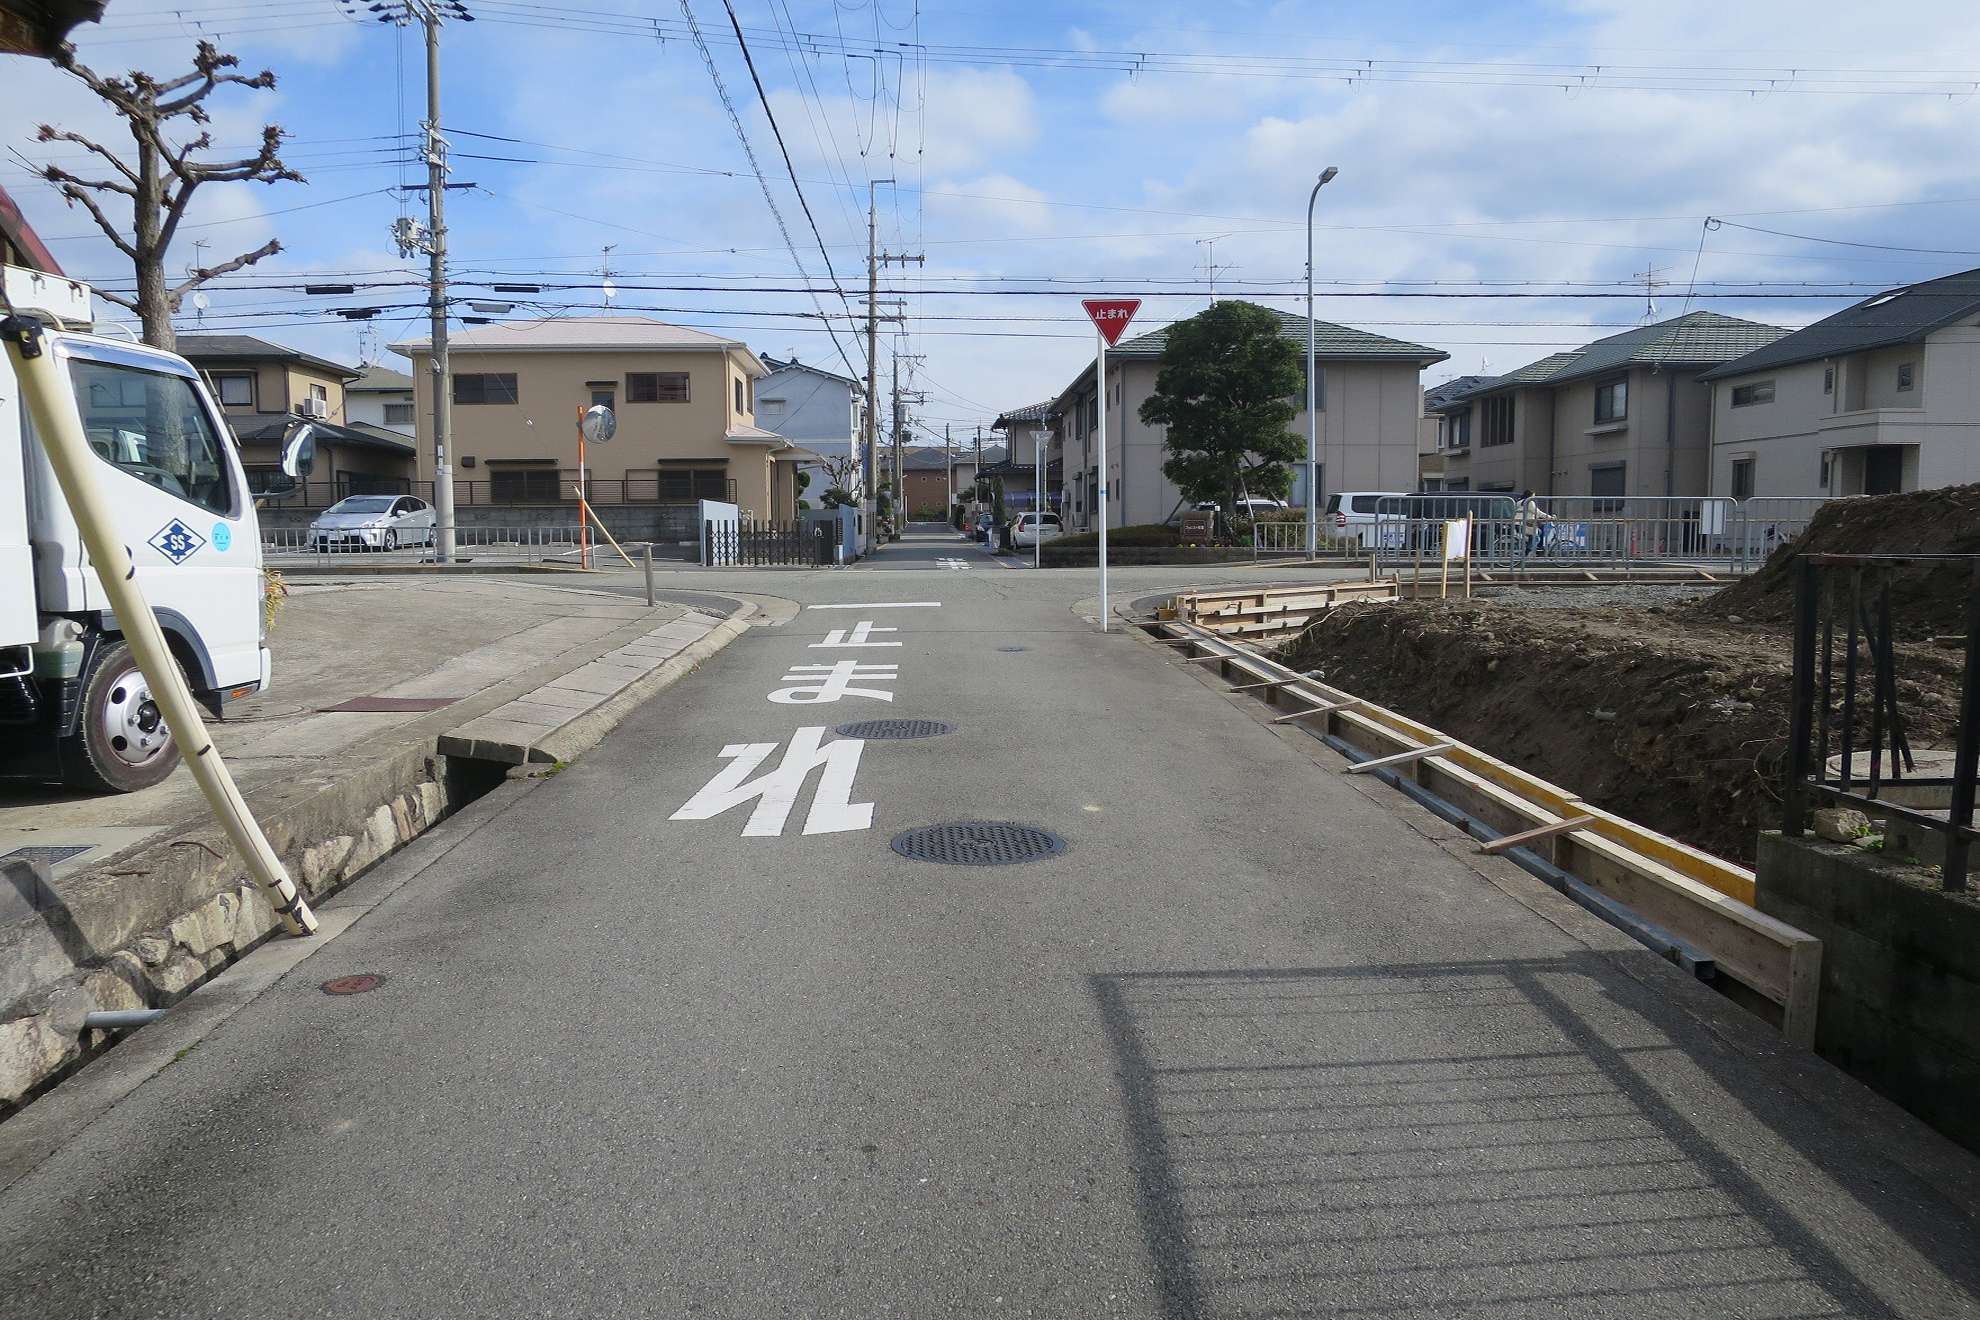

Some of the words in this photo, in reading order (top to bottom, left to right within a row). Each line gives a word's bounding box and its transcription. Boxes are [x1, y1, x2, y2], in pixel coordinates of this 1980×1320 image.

[1095, 309, 1128, 320] 止まれ
[170, 534, 185, 551] SS
[668, 621, 903, 837] 止まれ
